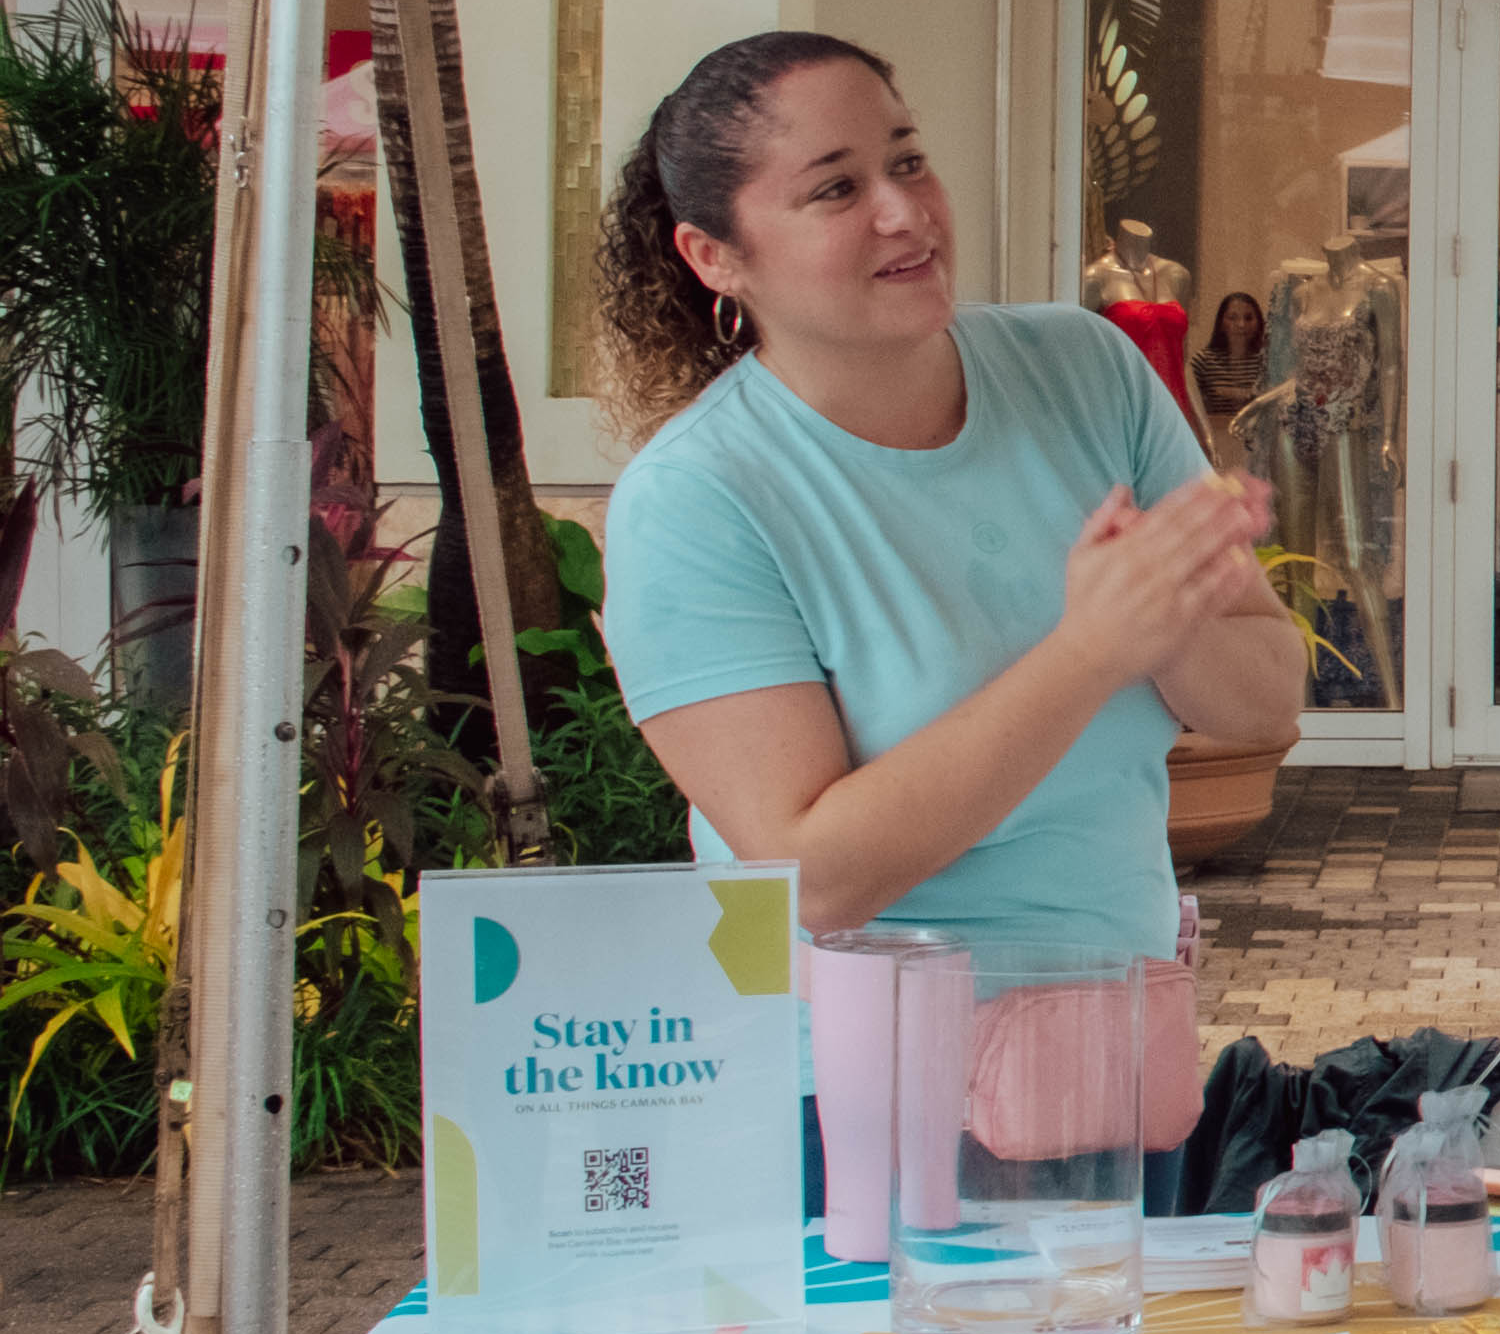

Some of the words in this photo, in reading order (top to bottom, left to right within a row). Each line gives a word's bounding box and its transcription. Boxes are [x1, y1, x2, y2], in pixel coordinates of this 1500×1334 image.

[532, 1012, 638, 1056] Stay
[649, 1006, 695, 1044] in
[504, 1056, 584, 1095] the
[595, 1053, 725, 1091] know
[514, 1104, 535, 1115] ON
[538, 1102, 561, 1113] ALL
[568, 1099, 617, 1112] THINGS
[620, 1096, 676, 1109] CAMANA
[679, 1094, 704, 1106] BAY
